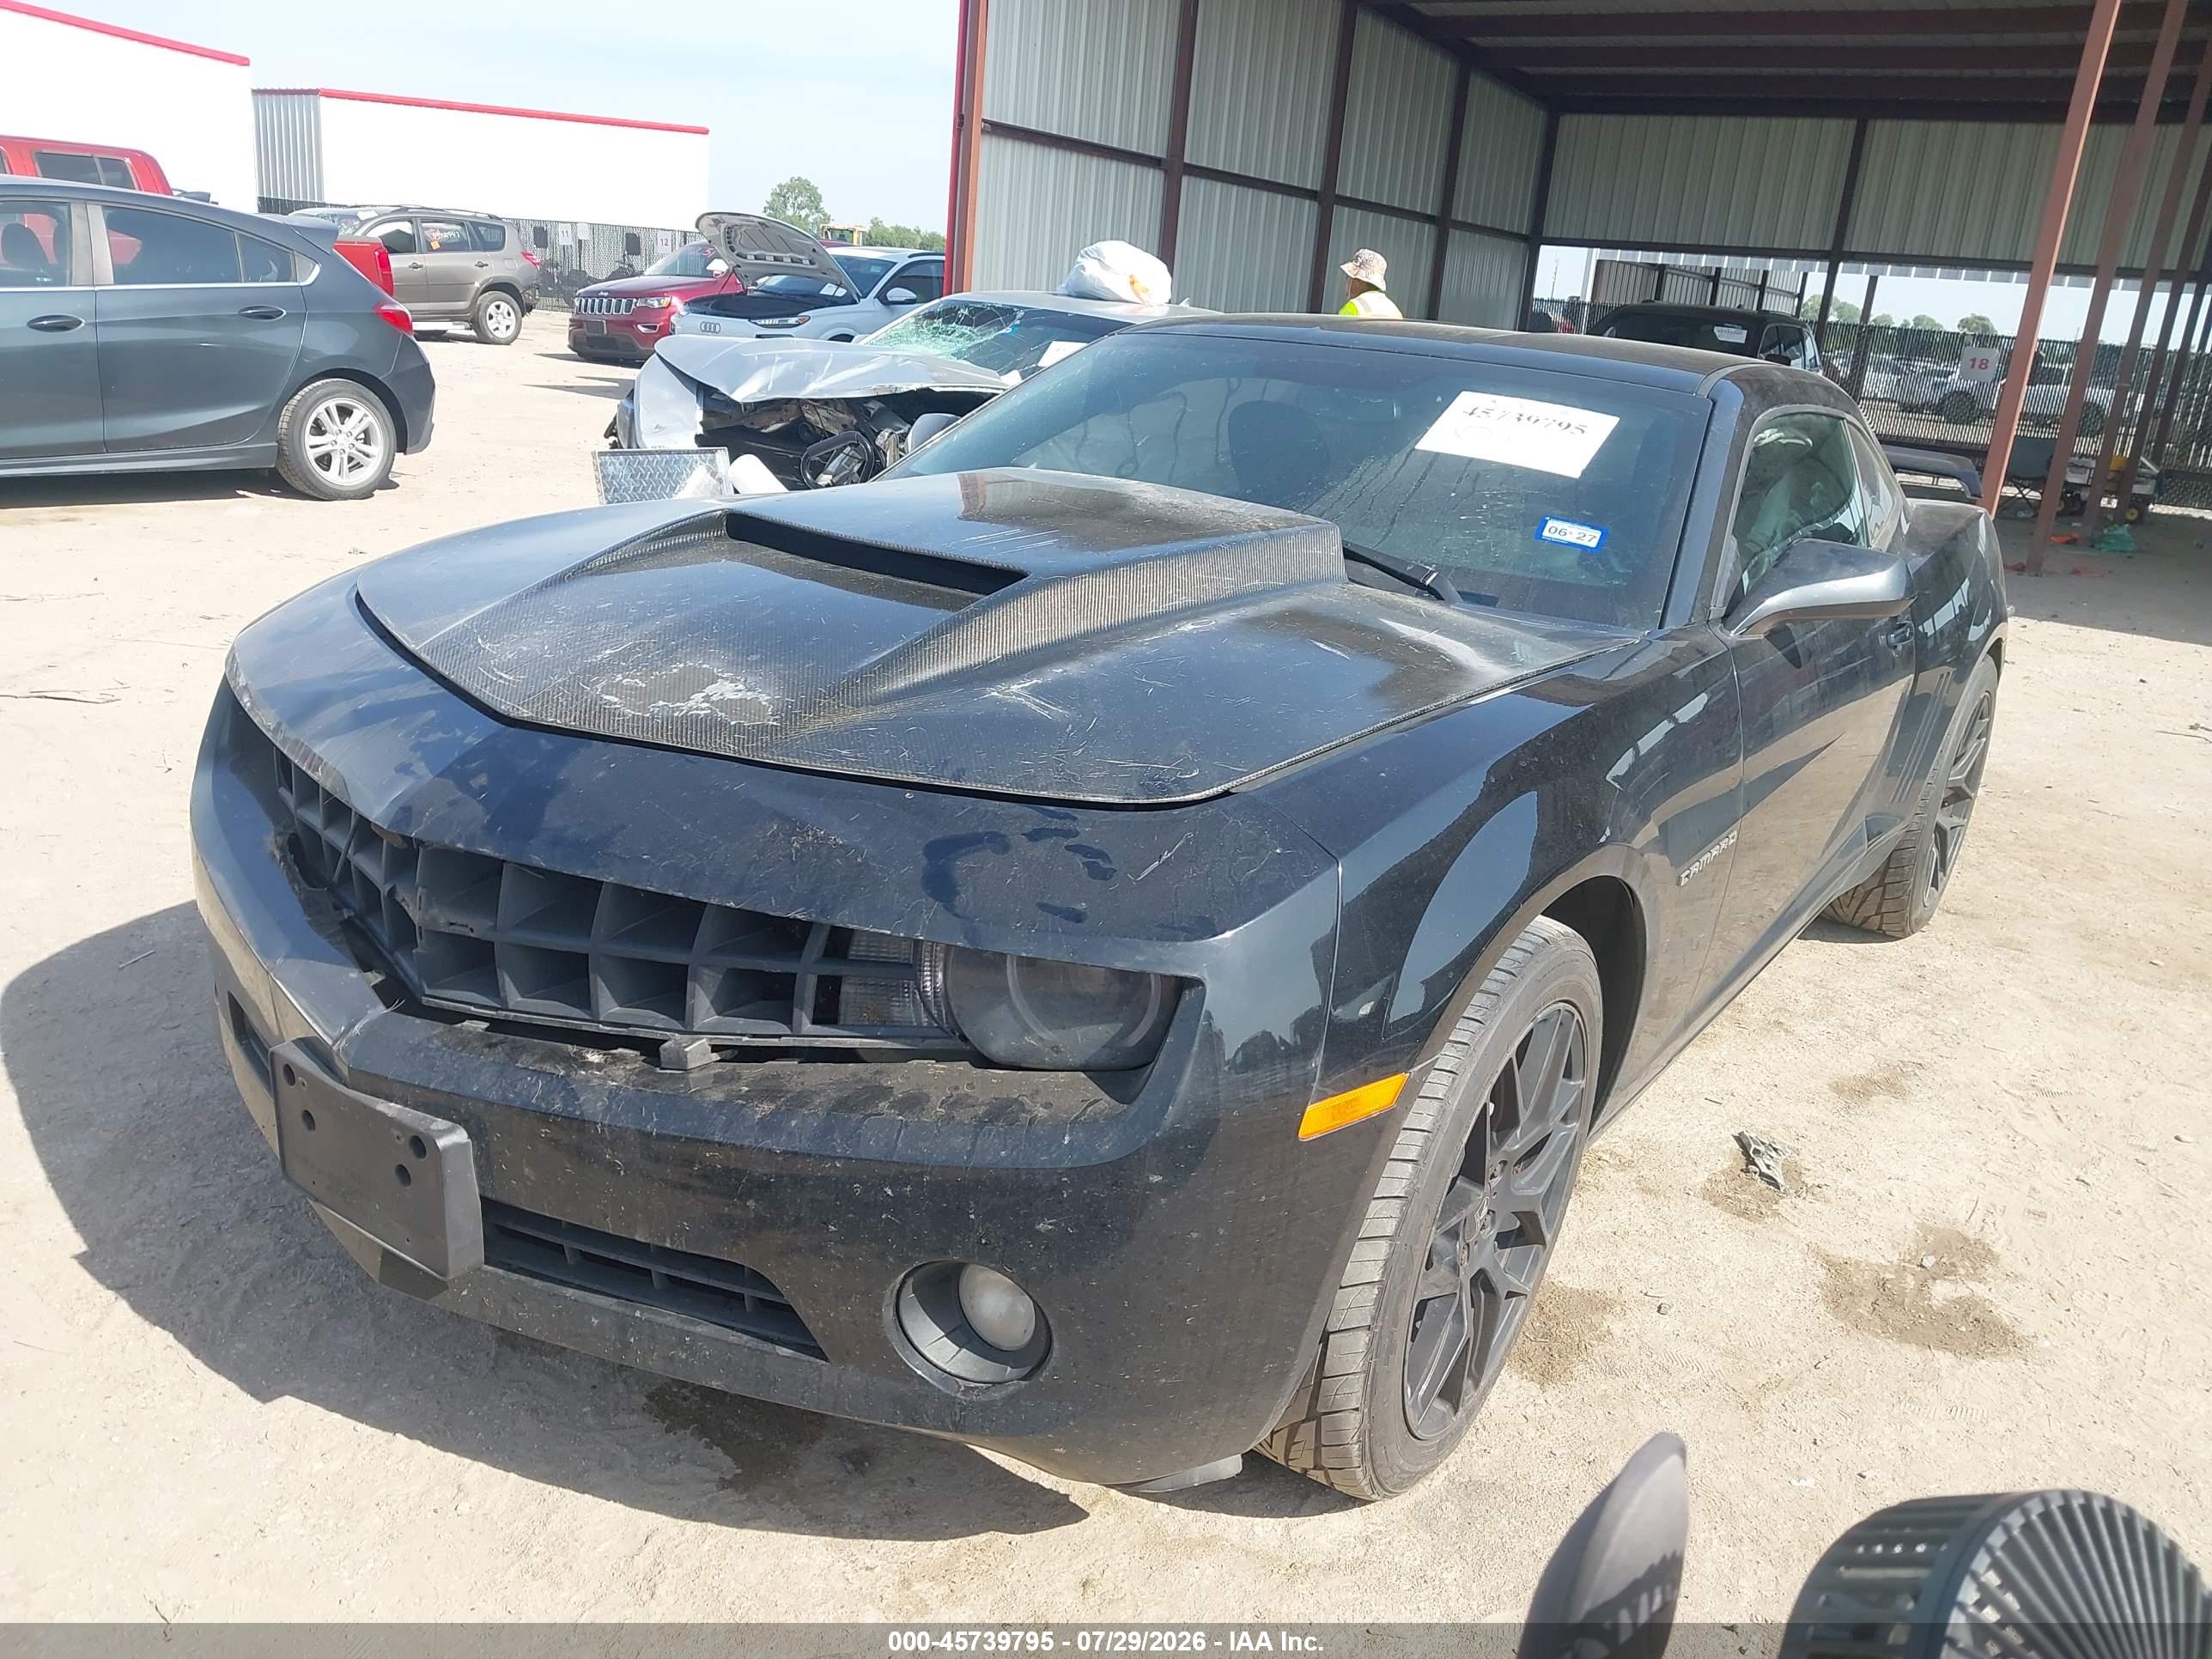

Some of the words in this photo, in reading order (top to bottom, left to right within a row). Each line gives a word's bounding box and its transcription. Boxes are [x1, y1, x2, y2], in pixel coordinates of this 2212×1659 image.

[660, 238, 669, 246] 12
[1969, 357, 1990, 370] 18
[1548, 526, 1567, 537] 06
[1576, 532, 1597, 543] 27
[1680, 830, 1738, 887] CAMARO
